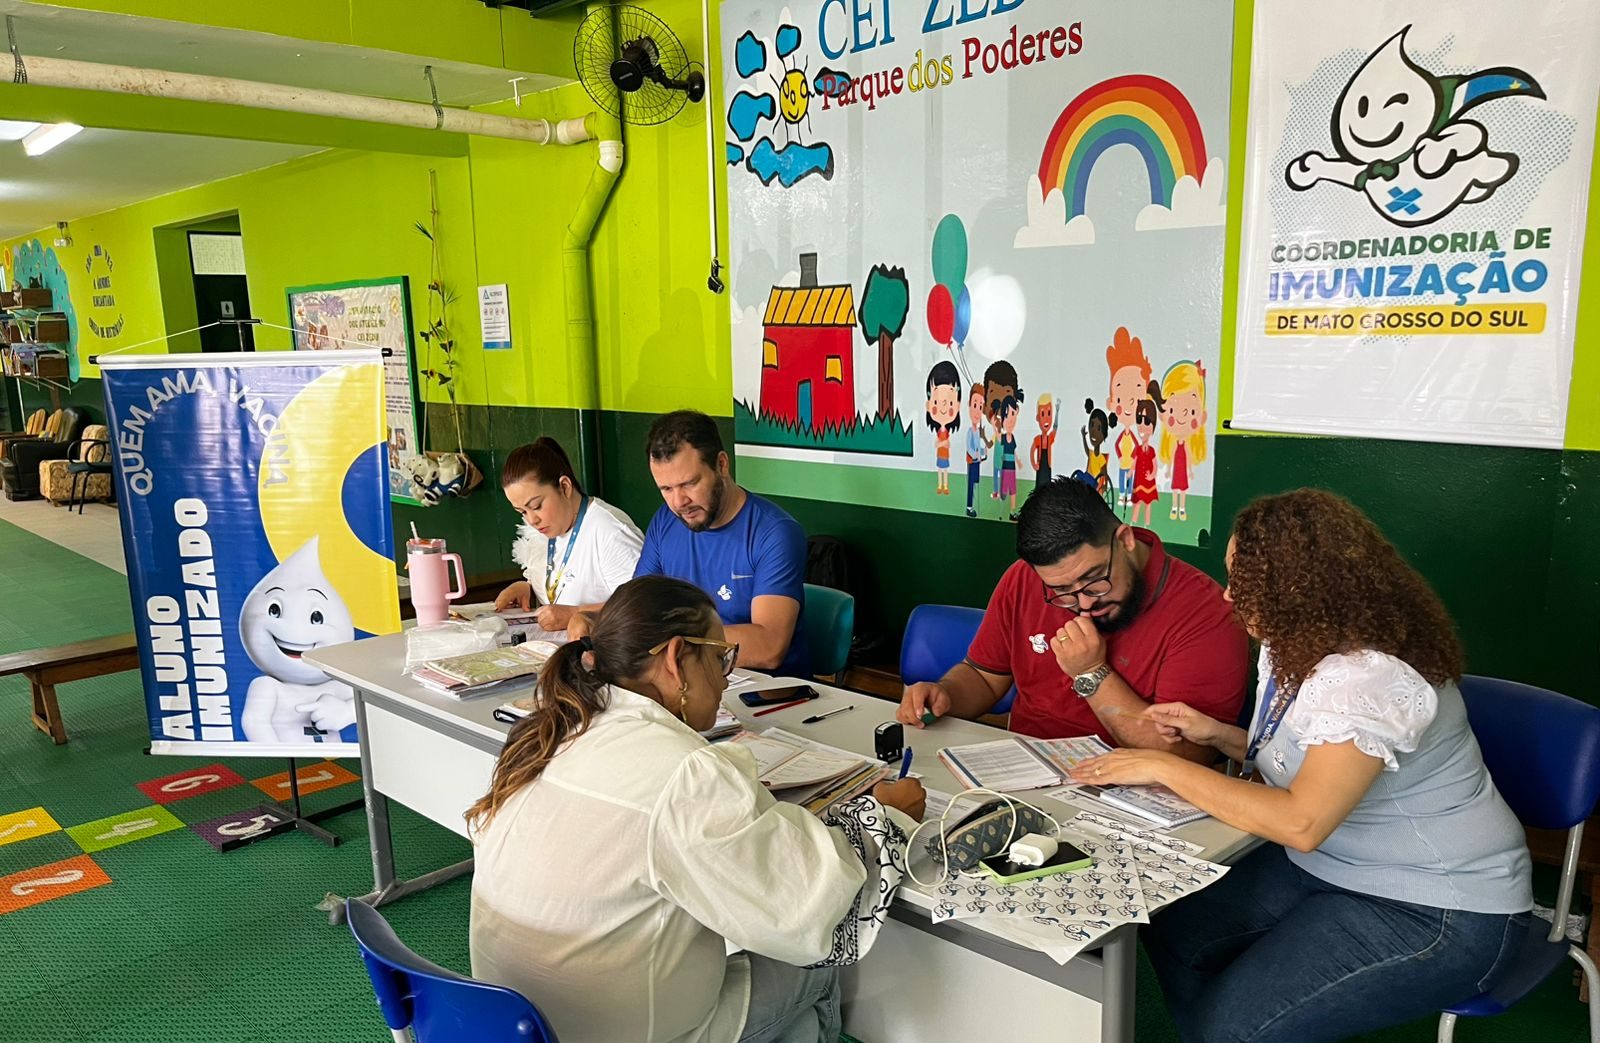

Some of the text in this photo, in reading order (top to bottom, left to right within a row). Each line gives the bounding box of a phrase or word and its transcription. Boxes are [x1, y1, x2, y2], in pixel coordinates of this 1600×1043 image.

[818, 0, 895, 60] CEI
[821, 21, 1084, 111] Parque dos Poderes
[1268, 251, 1548, 306] IMUNIZAÇÃO
[1271, 227, 1552, 263] COORDENADORIA DE
[1277, 310, 1528, 330] DE MATO GROSSO DO SUL
[120, 405, 153, 496] QUEM
[174, 498, 234, 742] IMUNIZADO
[147, 595, 195, 741] ALUNO
